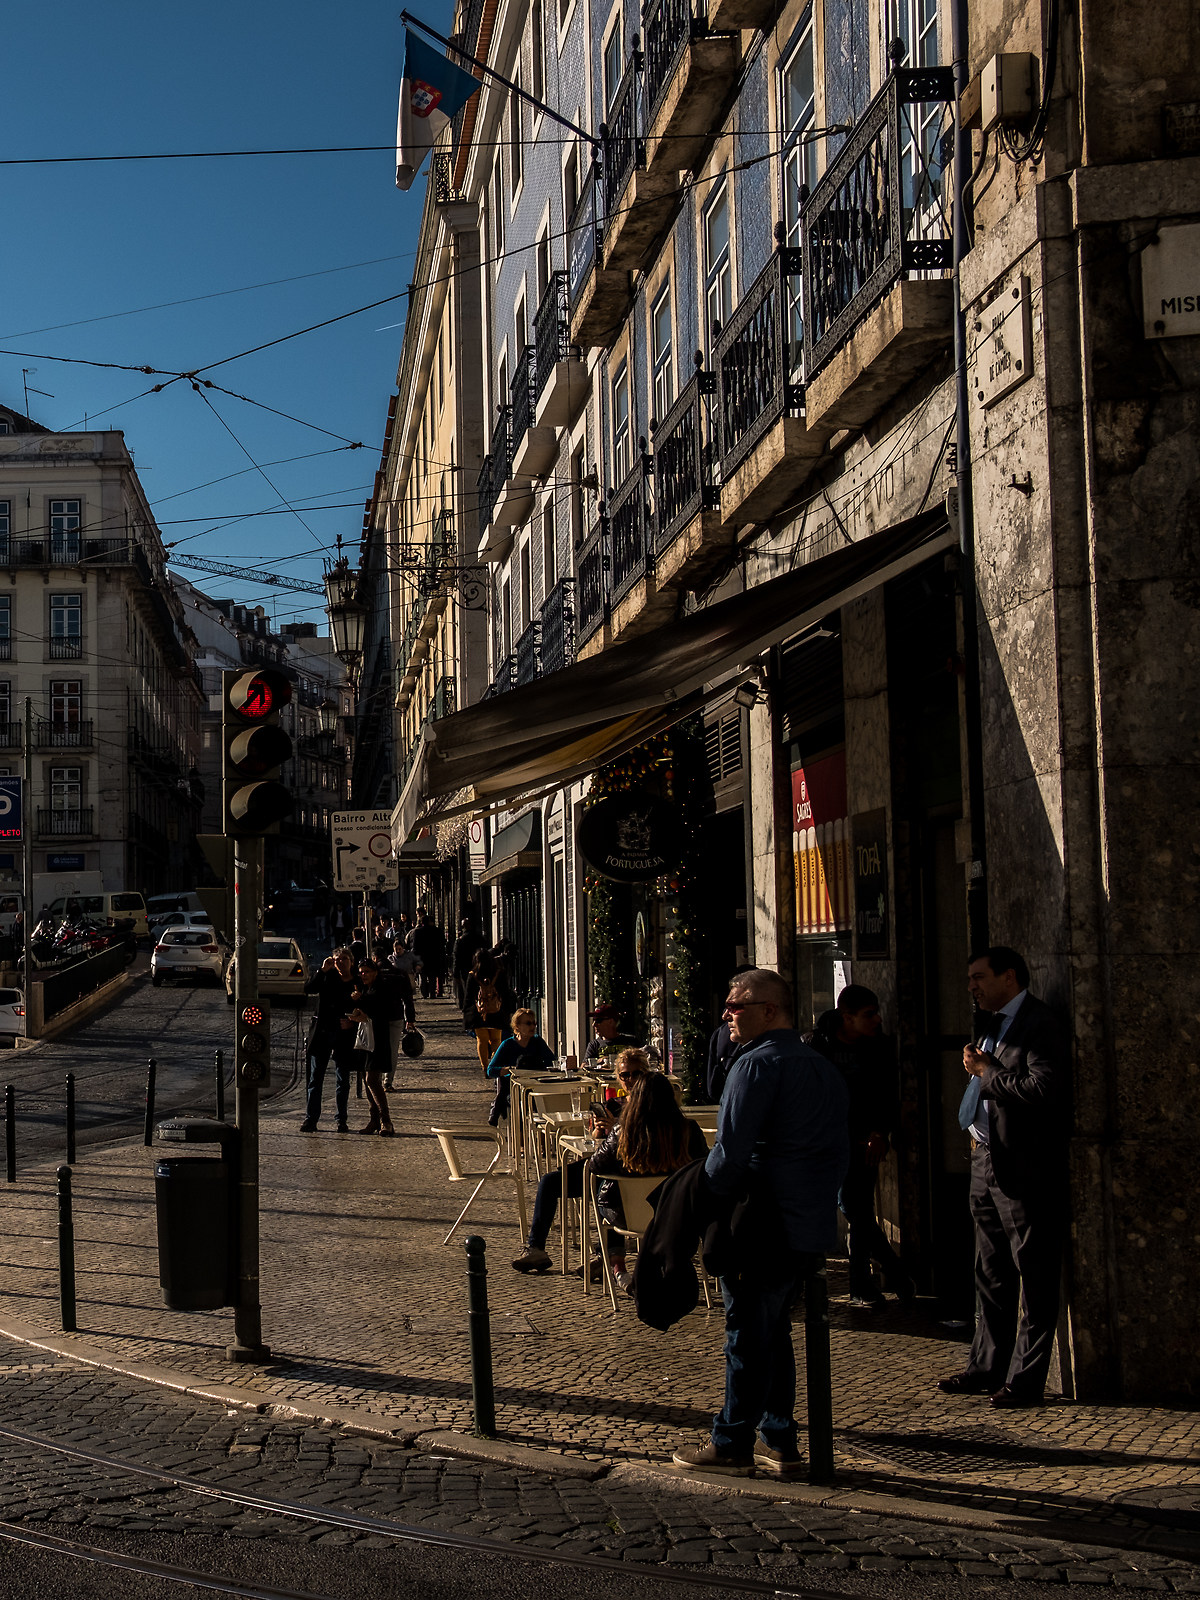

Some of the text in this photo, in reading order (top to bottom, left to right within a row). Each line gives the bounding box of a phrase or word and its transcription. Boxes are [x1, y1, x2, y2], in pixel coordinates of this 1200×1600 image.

[989, 364, 995, 383] DE
[333, 814, 366, 823] Bairro
[796, 800, 812, 823] SAGRES
[605, 854, 665, 870] PORTUGUESA
[856, 841, 881, 876] TOFA
